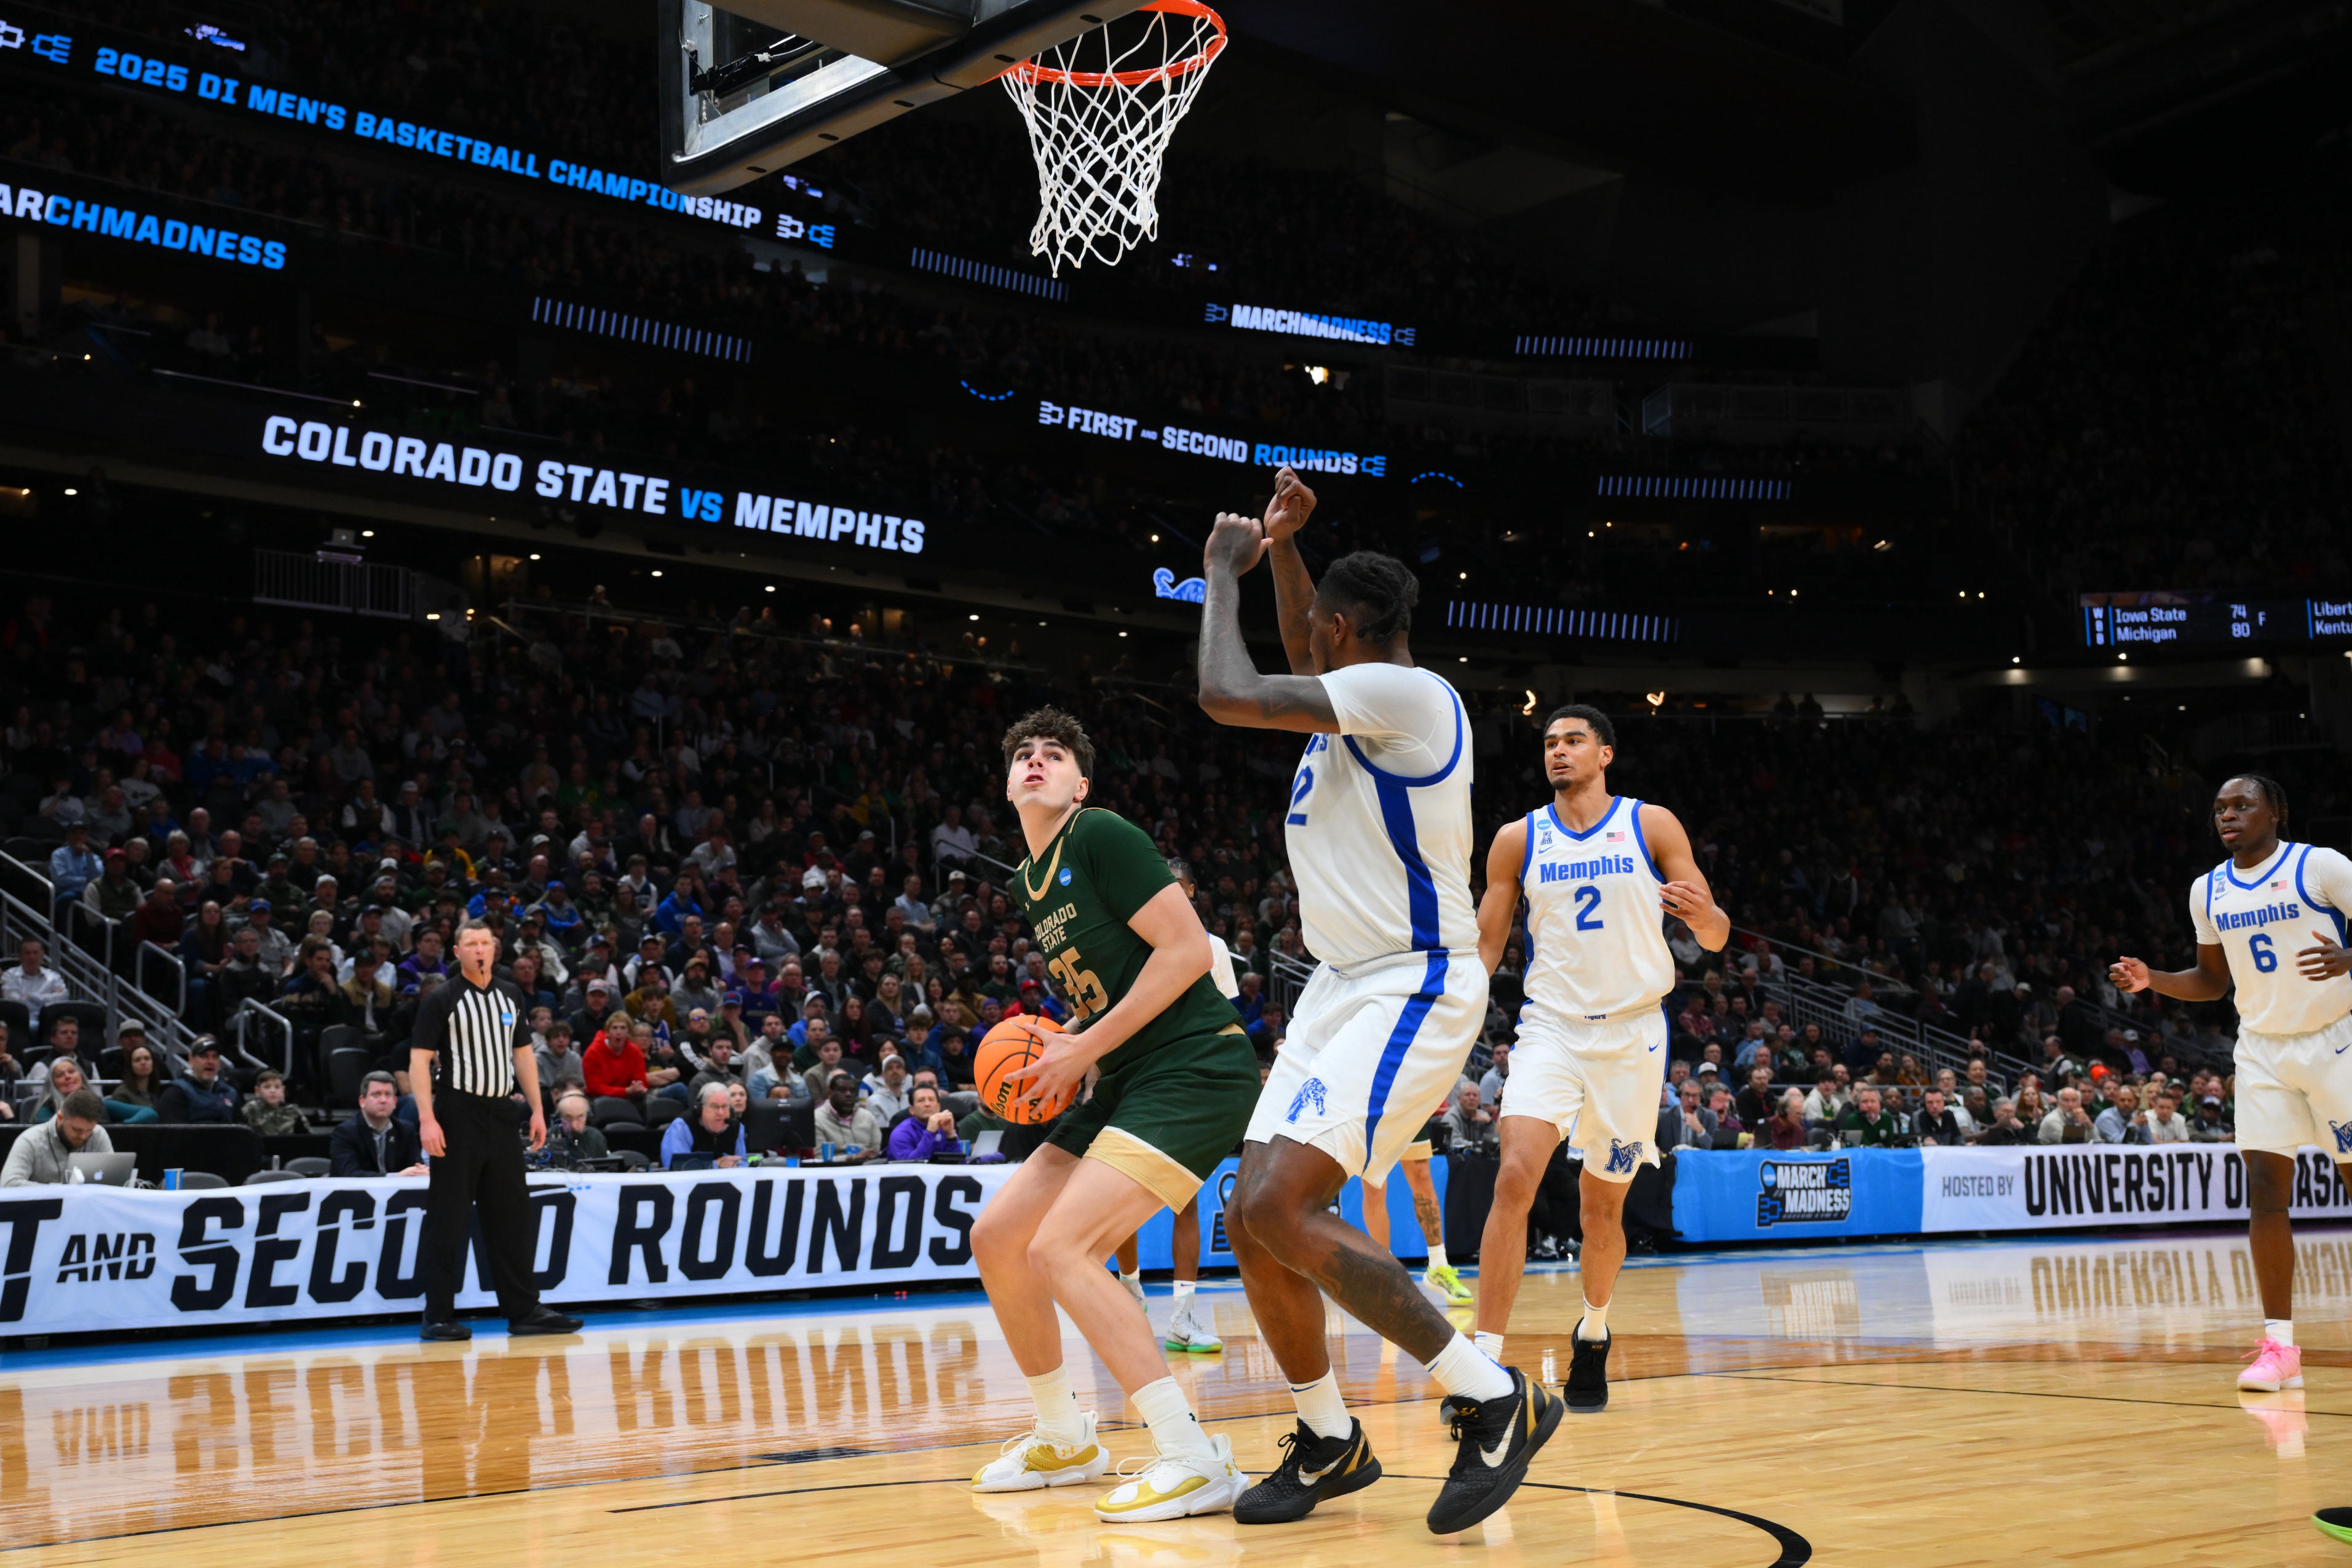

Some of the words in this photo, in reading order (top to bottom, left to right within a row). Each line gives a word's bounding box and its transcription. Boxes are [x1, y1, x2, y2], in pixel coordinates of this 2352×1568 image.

[95, 47, 189, 92] 2025
[198, 73, 240, 105] DI
[248, 85, 347, 131] MEN'S
[355, 111, 541, 179] BASKETBALL
[548, 160, 762, 229] CHAMPIONSHIP
[1231, 304, 1392, 346] MARCHMADNESS
[1067, 406, 1138, 441] FIRST
[1141, 429, 1158, 441] AND
[1162, 426, 1249, 464] SECOND
[1254, 443, 1358, 475] ROUNDS
[262, 415, 523, 492] COLORADO
[535, 460, 668, 515] STATE
[681, 488, 724, 523] VS
[734, 492, 926, 555] MEMPHIS
[2115, 608, 2148, 624] Iowa
[2150, 607, 2187, 623] State
[2230, 604, 2247, 619] 74
[2258, 611, 2267, 627] F
[2116, 625, 2178, 644] Michigan
[2231, 622, 2251, 638] 80
[1539, 854, 1634, 884] Memphis
[1574, 885, 1604, 932] 2
[2214, 901, 2300, 932] Memphis
[1041, 925, 1067, 953] STATE
[2248, 933, 2278, 973] 6
[1048, 946, 1108, 1022] 35
[1776, 1165, 1827, 1189] MARCH
[1942, 1175, 1995, 1198] HOSTED
[1997, 1174, 2014, 1196] BY
[2024, 1152, 2212, 1216] UNIVERSITY
[2223, 1153, 2251, 1209] O
[2287, 1154, 2350, 1207] ASH
[1784, 1187, 1851, 1214] MADNESS
[57, 1233, 156, 1283] AND
[608, 1175, 983, 1286] ROUNDS
